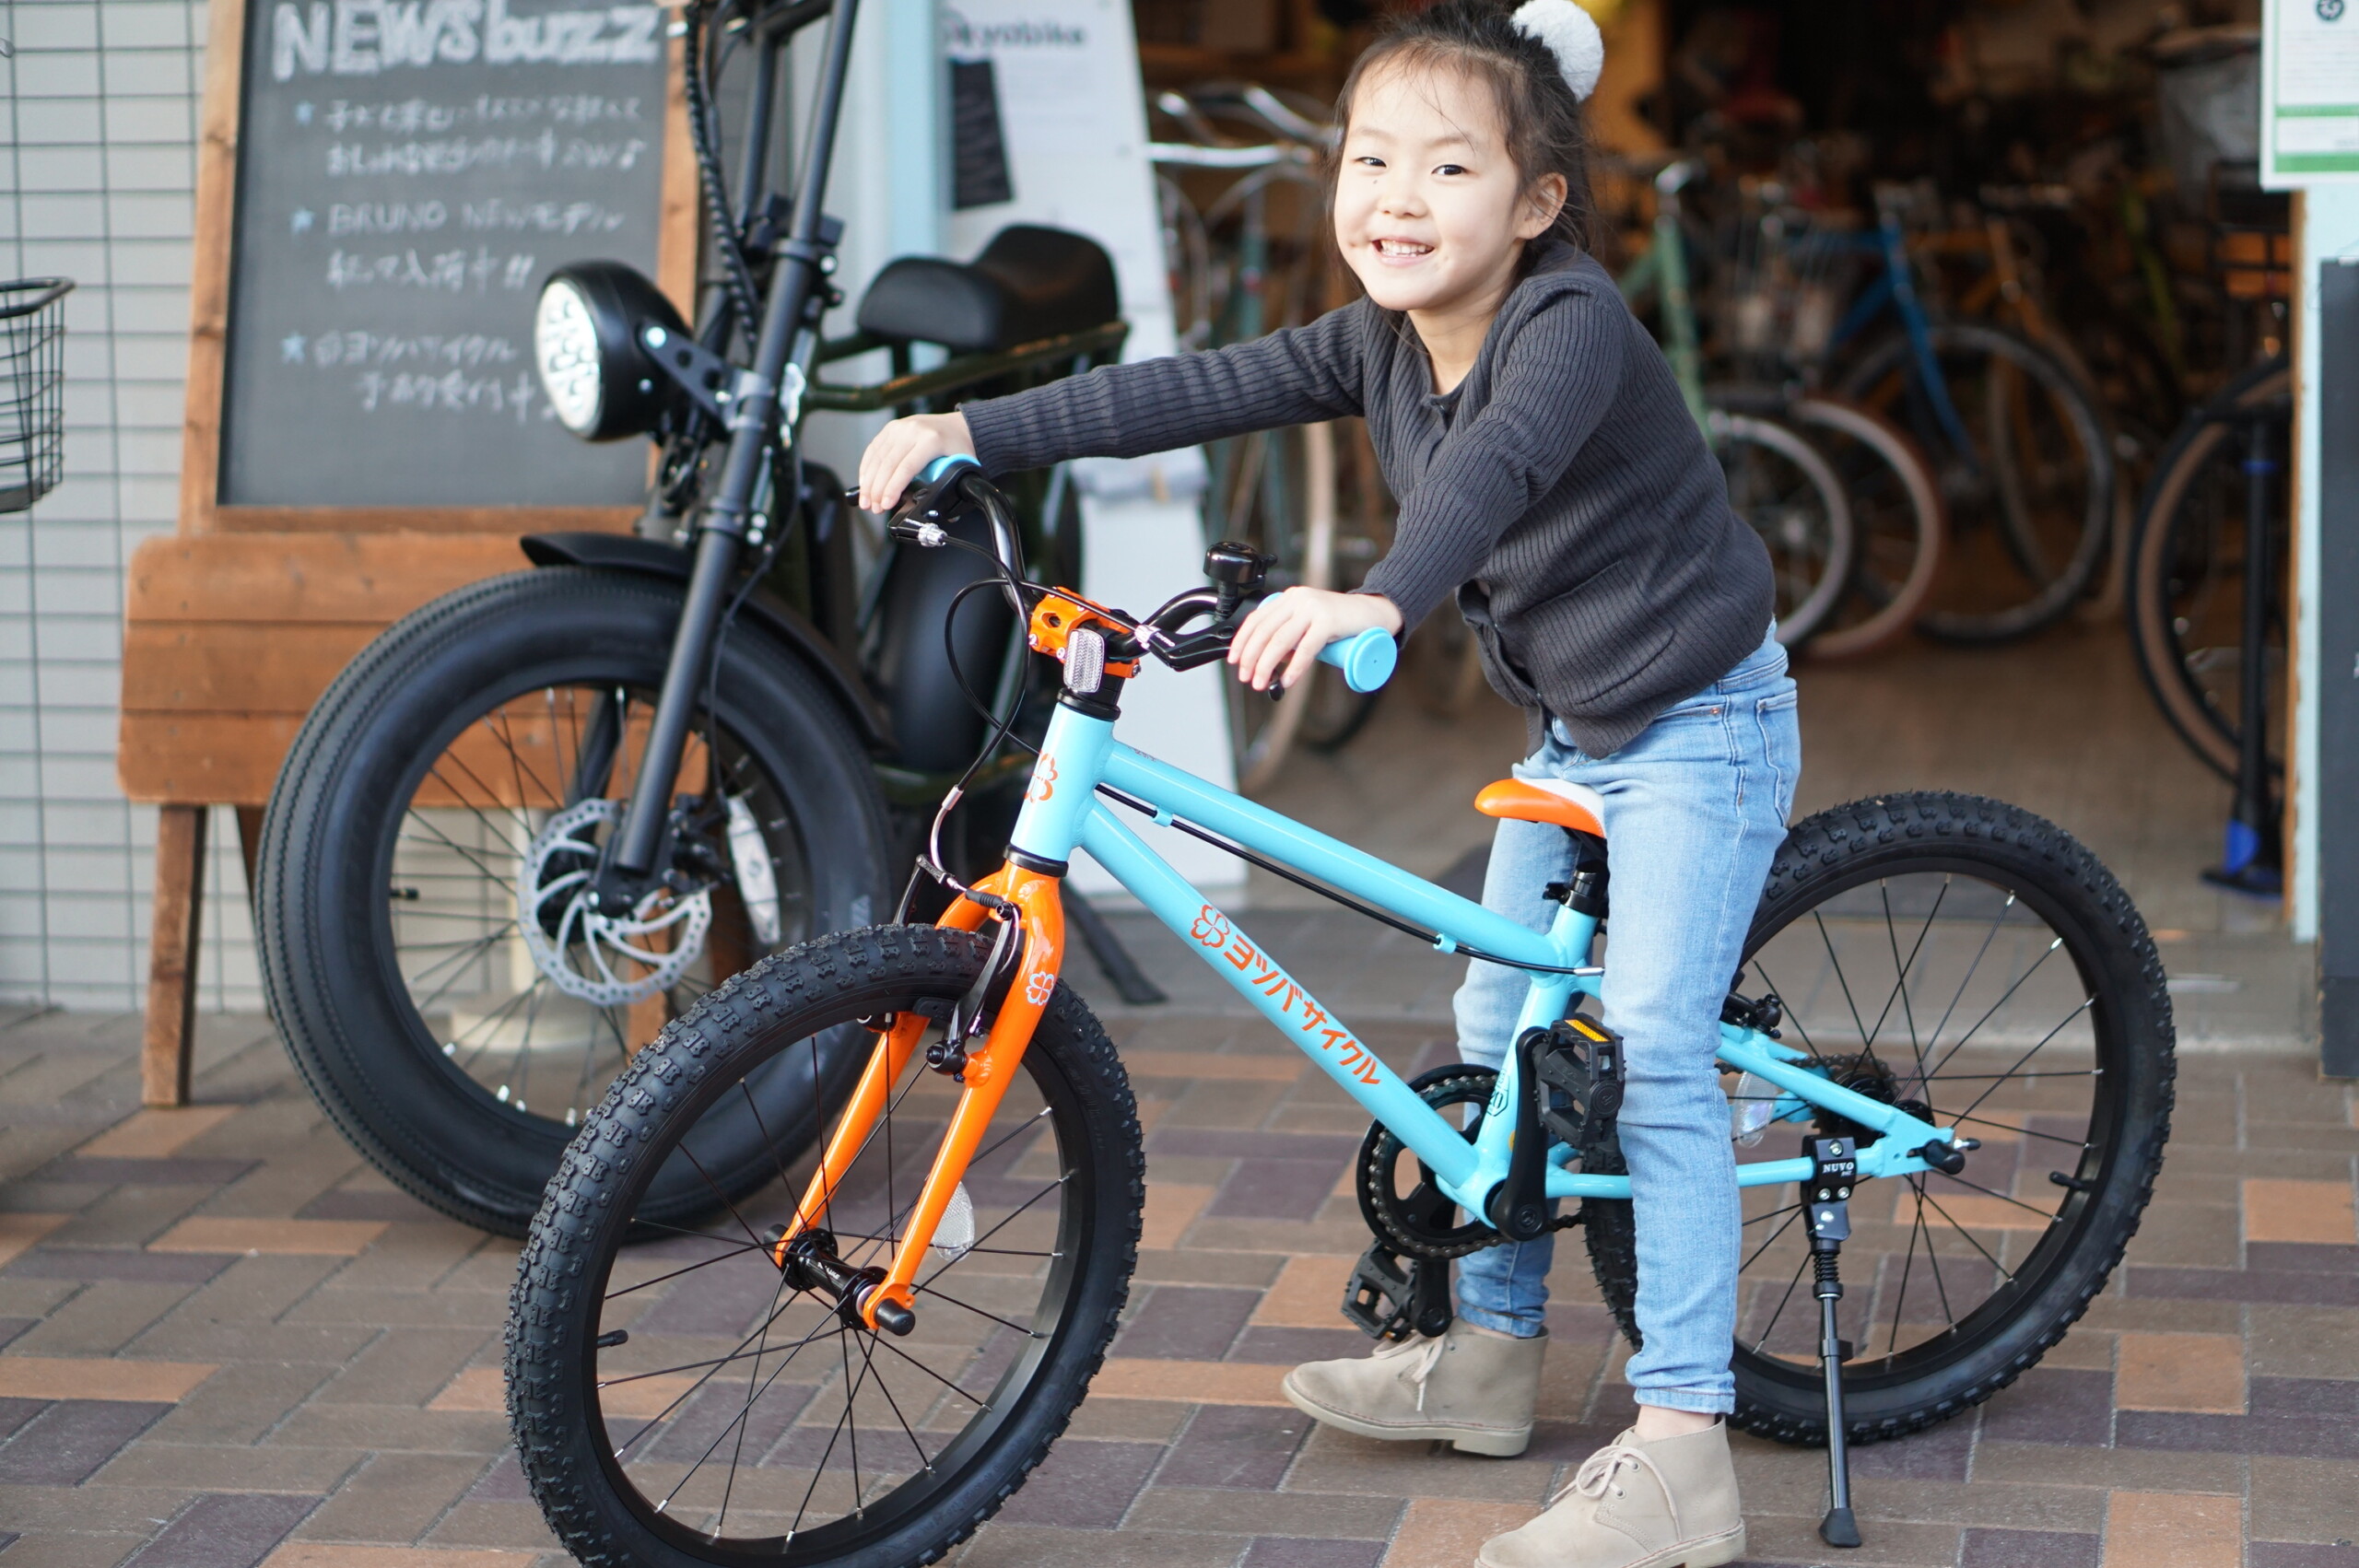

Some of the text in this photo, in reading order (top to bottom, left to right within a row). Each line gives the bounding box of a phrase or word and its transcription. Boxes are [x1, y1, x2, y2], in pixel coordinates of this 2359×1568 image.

[327, 199, 447, 238] BRUNO
[1224, 934, 1380, 1085] ヨツバサイクル
[1823, 1161, 1854, 1174] NUVO
